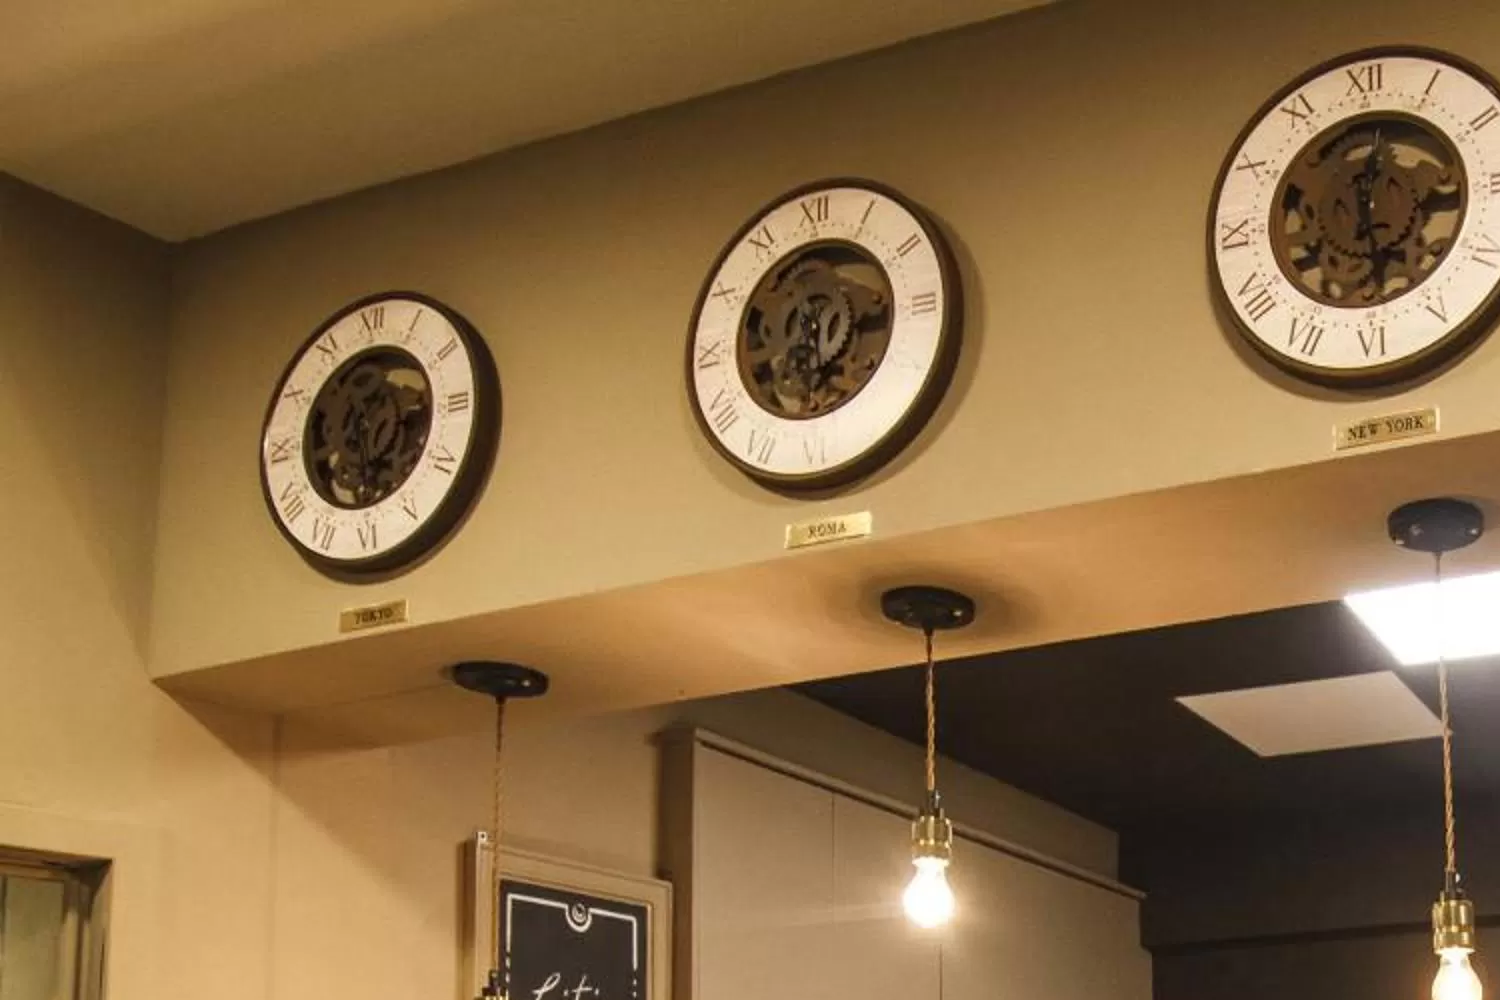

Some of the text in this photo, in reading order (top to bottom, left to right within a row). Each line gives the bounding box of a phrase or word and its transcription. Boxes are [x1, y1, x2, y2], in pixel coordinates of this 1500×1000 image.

[1345, 64, 1384, 97] XII
[1424, 69, 1441, 97] I
[1280, 93, 1316, 128] XI
[1469, 104, 1500, 132] II
[1235, 152, 1267, 182] X
[1221, 219, 1250, 251] IX
[1237, 271, 1277, 323] VIII
[1426, 296, 1449, 324] V
[1286, 317, 1325, 358] VII
[1356, 326, 1386, 358] VI
[1348, 415, 1424, 440] NEW YORK
[807, 520, 847, 539] ROMA
